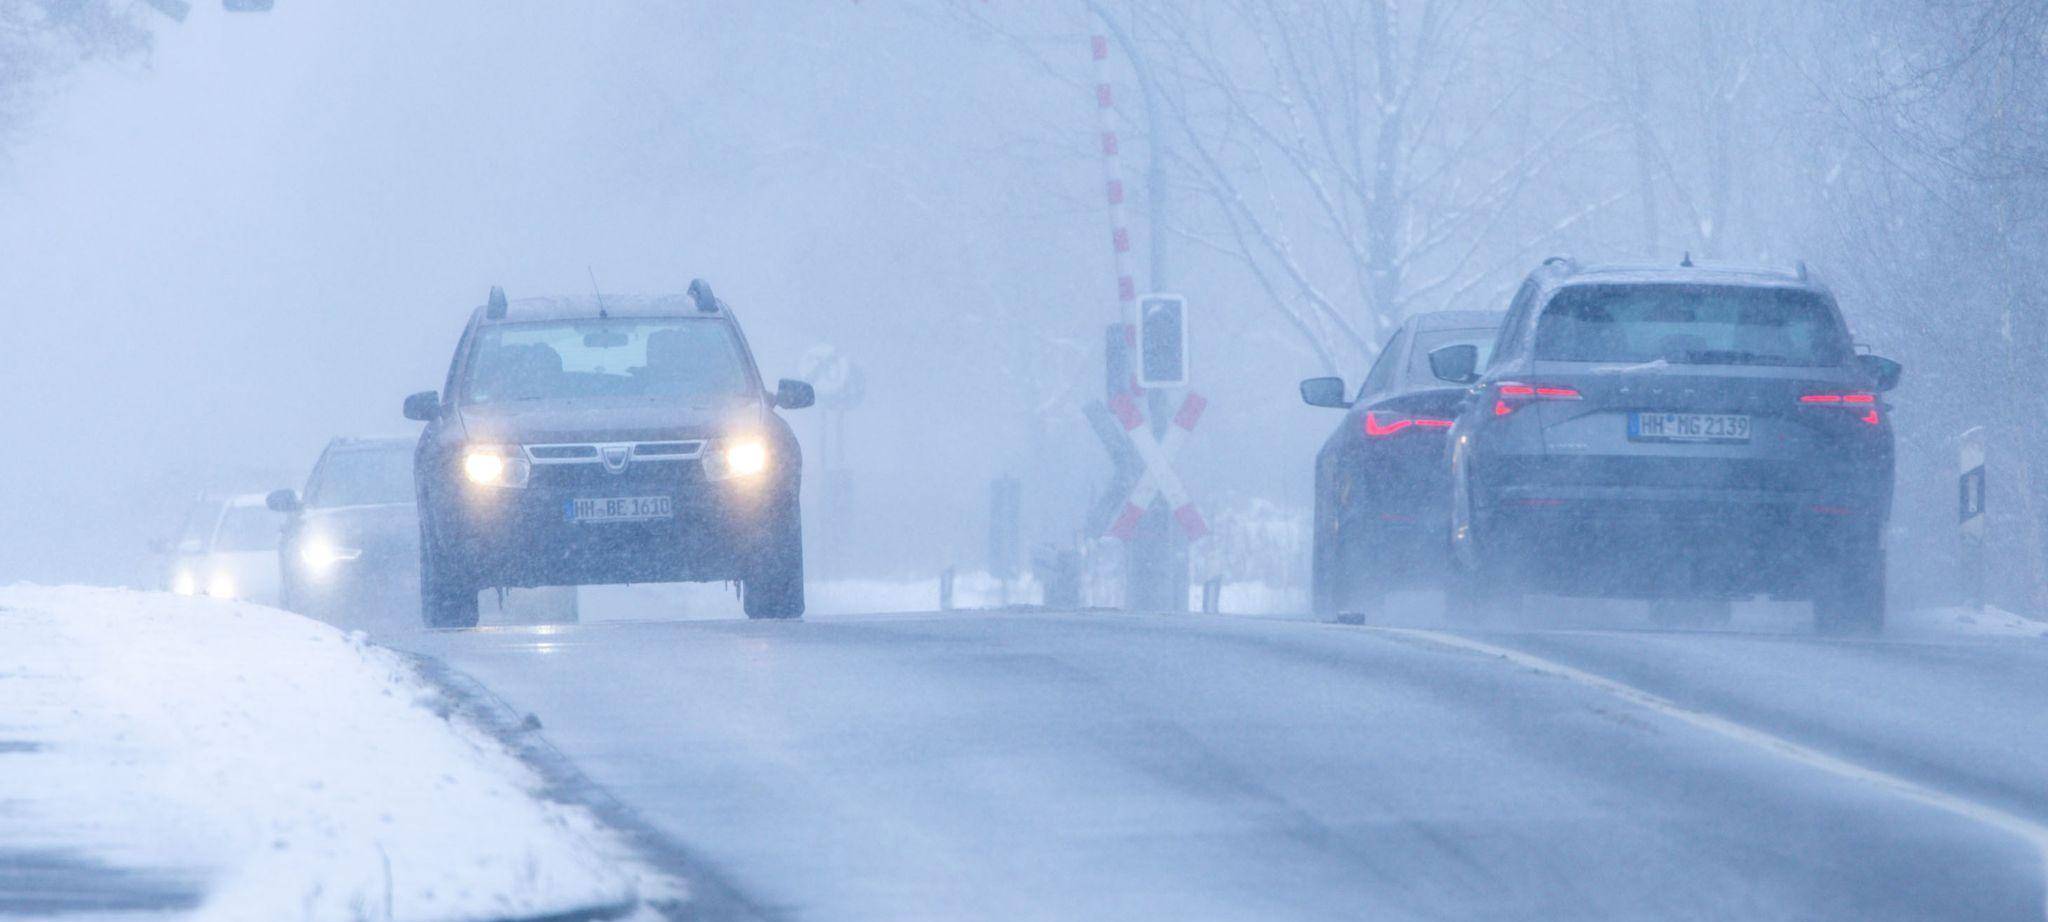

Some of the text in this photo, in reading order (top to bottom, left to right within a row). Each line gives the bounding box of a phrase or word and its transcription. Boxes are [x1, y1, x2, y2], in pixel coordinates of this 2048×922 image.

[1641, 414, 1748, 436] HH MG 2139
[574, 499, 670, 517] HH BE 1610
